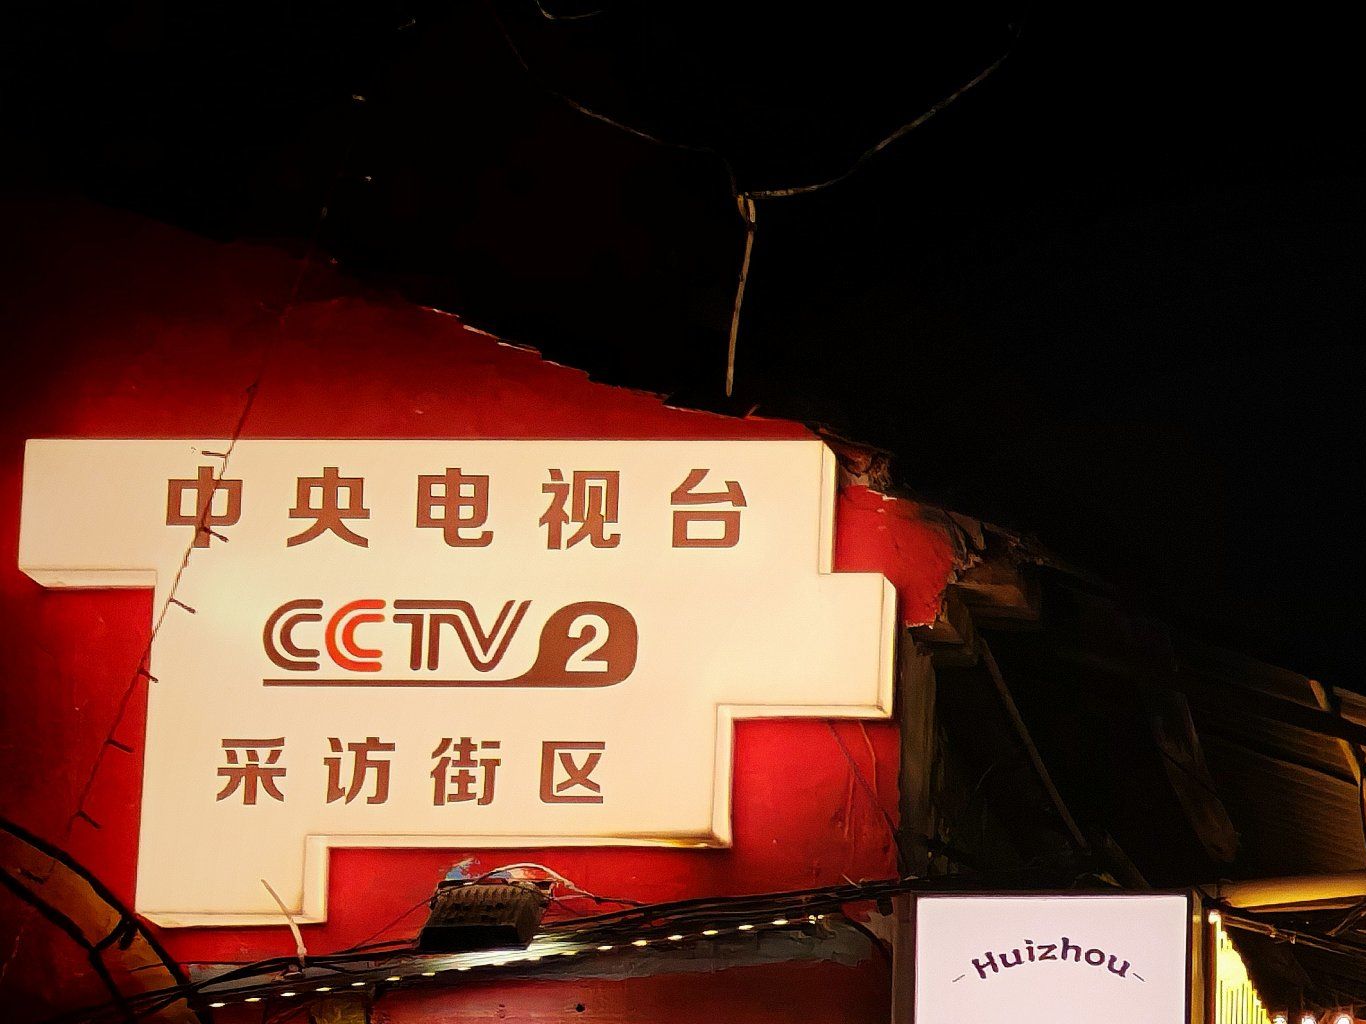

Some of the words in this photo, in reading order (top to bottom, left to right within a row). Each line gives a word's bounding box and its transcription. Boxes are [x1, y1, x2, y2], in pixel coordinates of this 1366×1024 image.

[165, 464, 747, 551] 中央电视台
[216, 736, 607, 805] 采访街区
[970, 936, 1131, 981] Huizhou
